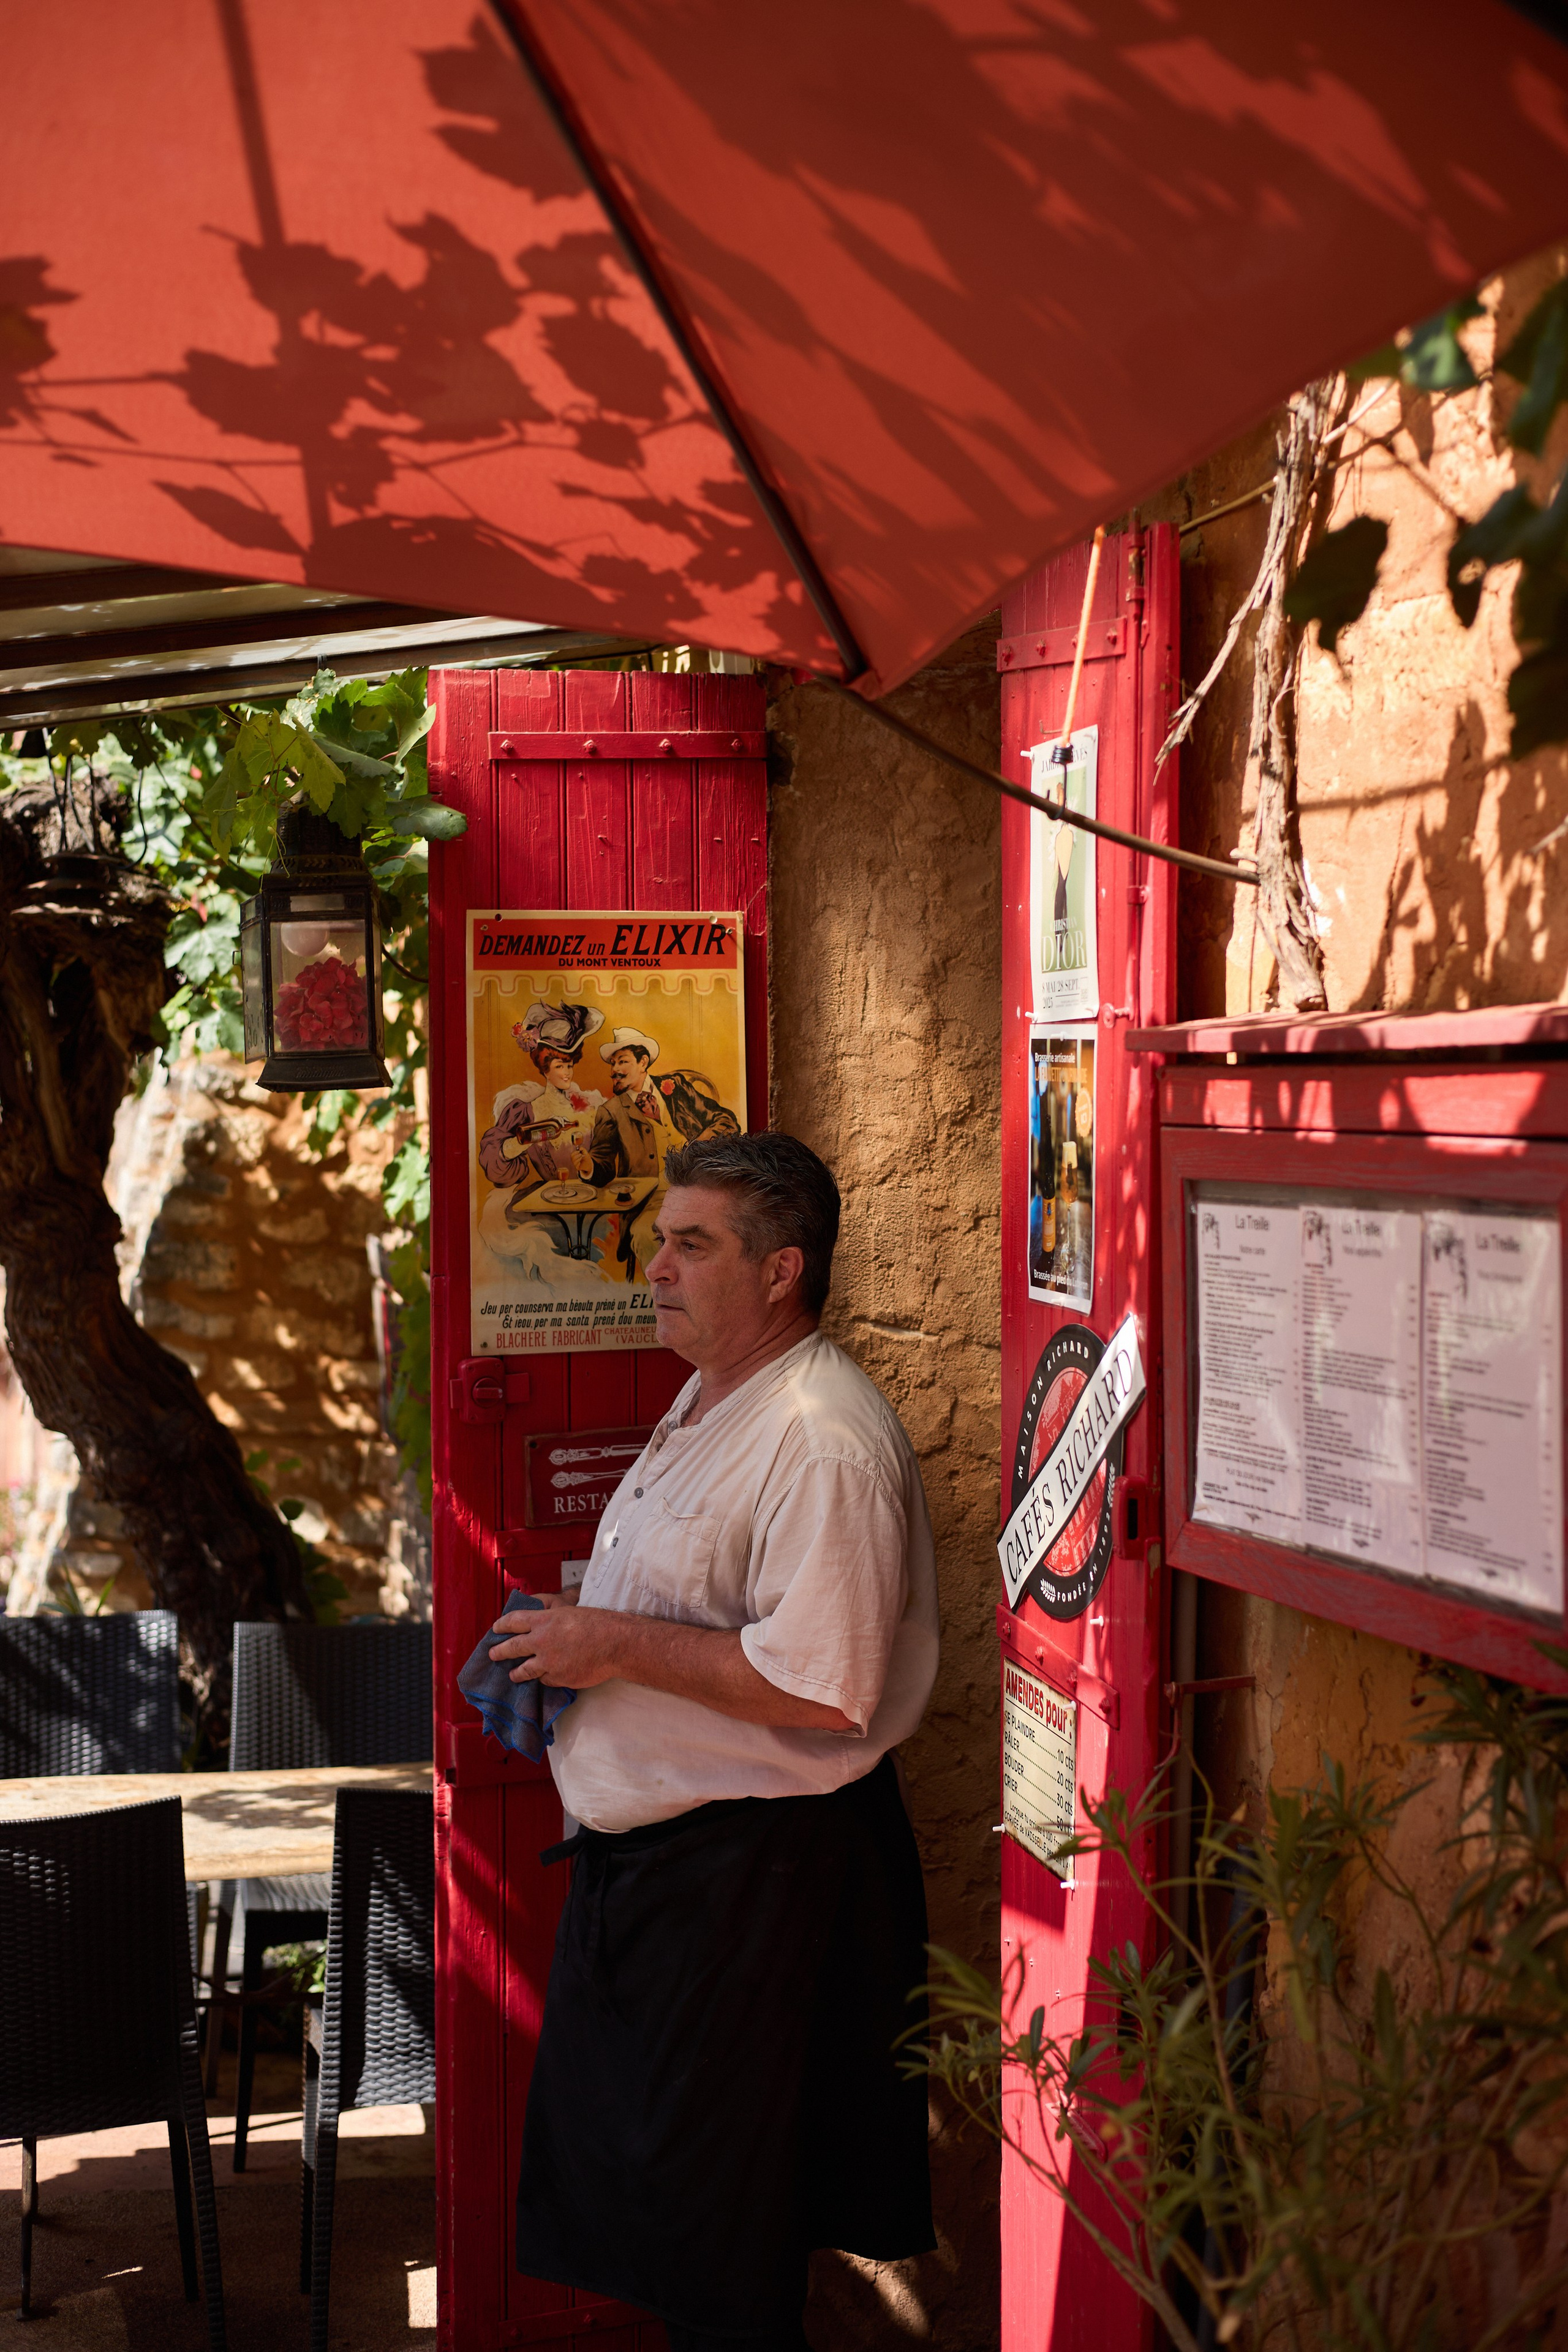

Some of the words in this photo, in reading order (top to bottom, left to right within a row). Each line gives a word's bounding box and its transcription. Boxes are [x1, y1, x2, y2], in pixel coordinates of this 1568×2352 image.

[1050, 917, 1077, 932] CHRISTIAN
[479, 935, 586, 956] DEMANDEZ
[587, 943, 605, 955] un
[609, 924, 726, 956] ELIXIR
[1042, 930, 1087, 971] DIOR
[559, 958, 574, 967] DU
[577, 958, 608, 967] MONT
[611, 958, 661, 967] VENTOUX
[1042, 982, 1046, 993] 8
[1046, 981, 1055, 993] MAI
[1035, 1052, 1054, 1062] Brasserie
[1054, 1052, 1076, 1063] artisanale
[1235, 1214, 1245, 1229] La
[1033, 1268, 1050, 1280] Brassée
[1057, 1274, 1066, 1286] pied
[481, 1301, 497, 1314] Jeu
[499, 1303, 513, 1317] per
[515, 1302, 554, 1313] counserva
[556, 1302, 567, 1312] ma
[617, 1300, 627, 1310] un
[502, 1314, 513, 1329] Et
[533, 1317, 548, 1330] per
[550, 1317, 562, 1327] ma
[566, 1314, 589, 1326] santa
[618, 1311, 633, 1325] dou
[496, 1331, 547, 1348] BLACHERE
[552, 1329, 601, 1346] FABRICANT
[616, 1334, 659, 1344] (VAUCL
[1018, 1376, 1043, 1479] MAISON
[1046, 1340, 1089, 1371] RICHARD
[1006, 1482, 1055, 1585] CAFÉS
[1055, 1349, 1133, 1507] RICHARD
[553, 1492, 615, 1513] RESTA
[1057, 1581, 1087, 1603] FONDÉE
[1090, 1562, 1098, 1581] EN
[1099, 1512, 1110, 1556] 1892
[1006, 1668, 1044, 1719] AMENDES
[1046, 1698, 1068, 1735] pour
[1005, 1709, 1011, 1725] SE
[1057, 1749, 1064, 1764] 10
[1065, 1755, 1074, 1771] cts
[1005, 1752, 1024, 1777] BOUDER
[1057, 1793, 1063, 1809] 30
[1065, 1800, 1073, 1816] cts
[1057, 1771, 1063, 1786] 20
[1004, 1773, 1018, 1794] CRIER
[1057, 1815, 1063, 1831] 50
[1010, 1800, 1023, 1820] Lorsque
[1005, 1811, 1019, 1830] CORVÉE
[1019, 1823, 1024, 1834] de
[1025, 1826, 1046, 1853] VAISSELLE
